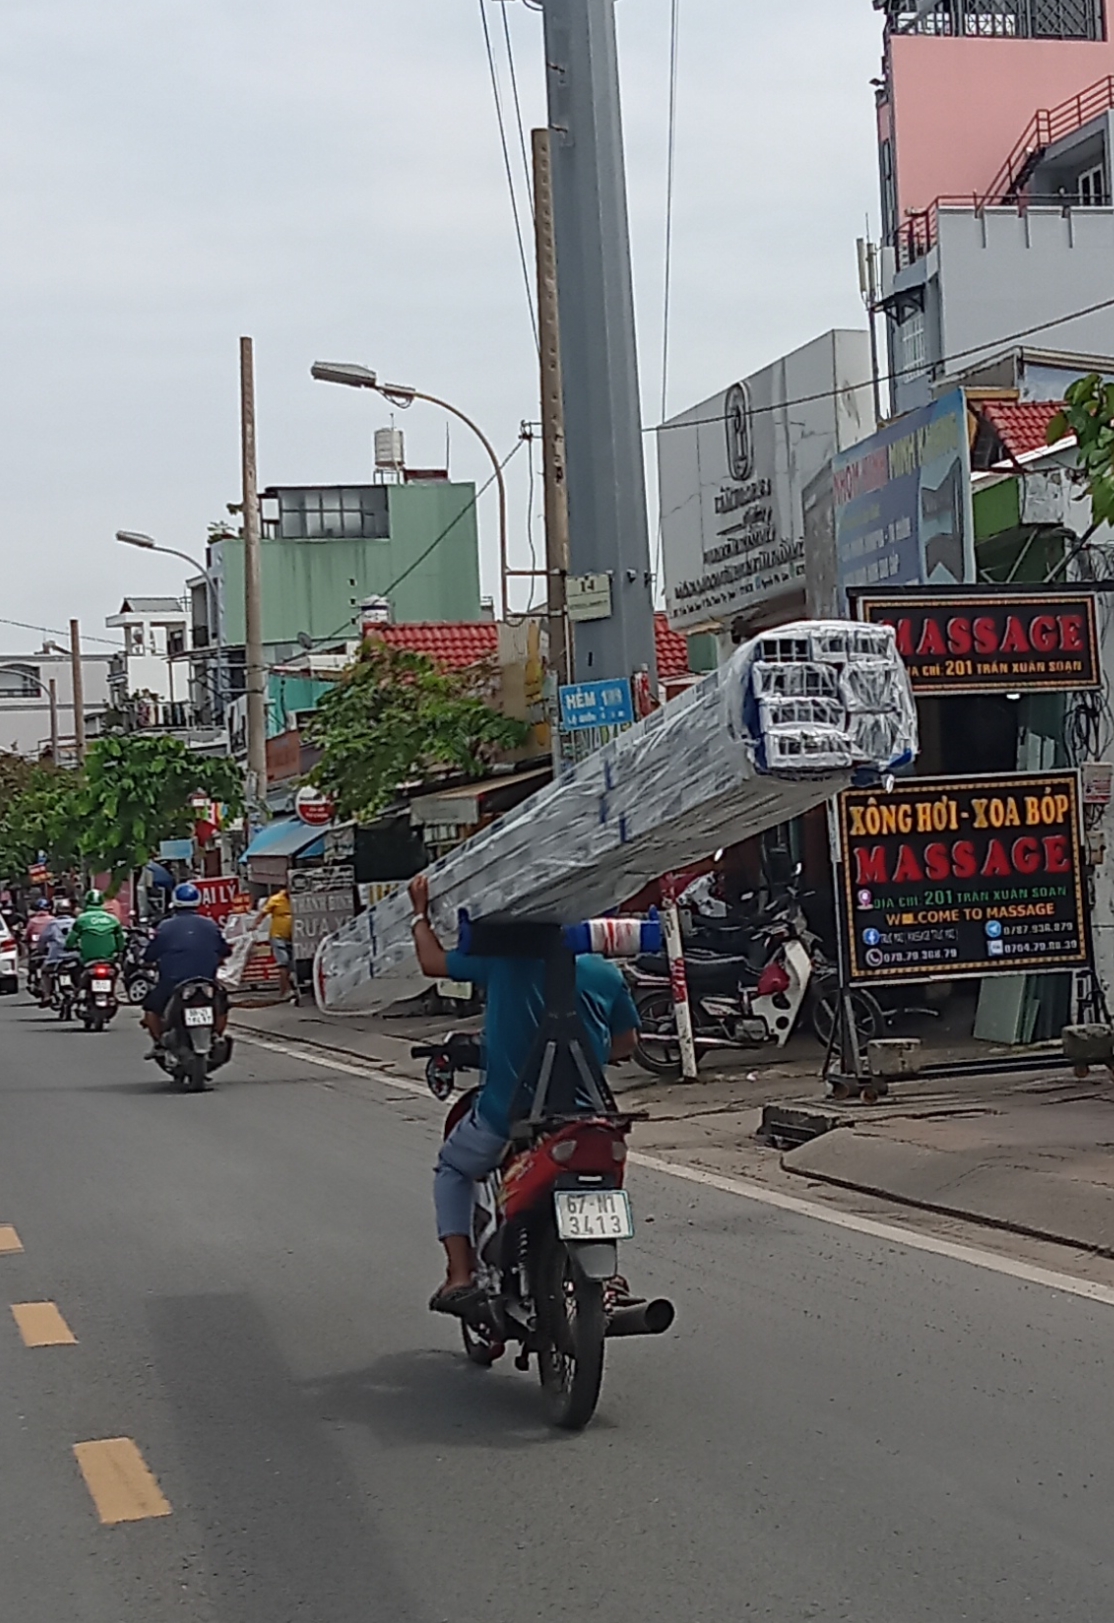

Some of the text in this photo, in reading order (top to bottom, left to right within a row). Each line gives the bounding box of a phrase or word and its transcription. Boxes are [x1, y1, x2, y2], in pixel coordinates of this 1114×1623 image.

[945, 660, 972, 676] 201
[850, 797, 912, 835] XÔNG
[916, 795, 959, 832] HƠI
[971, 797, 1020, 828] XOA
[853, 834, 1071, 885] MASSAGE
[924, 889, 954, 906] 201
[886, 902, 1055, 927] WLCOME TO MASSAGE
[569, 1215, 622, 1235] 3413
